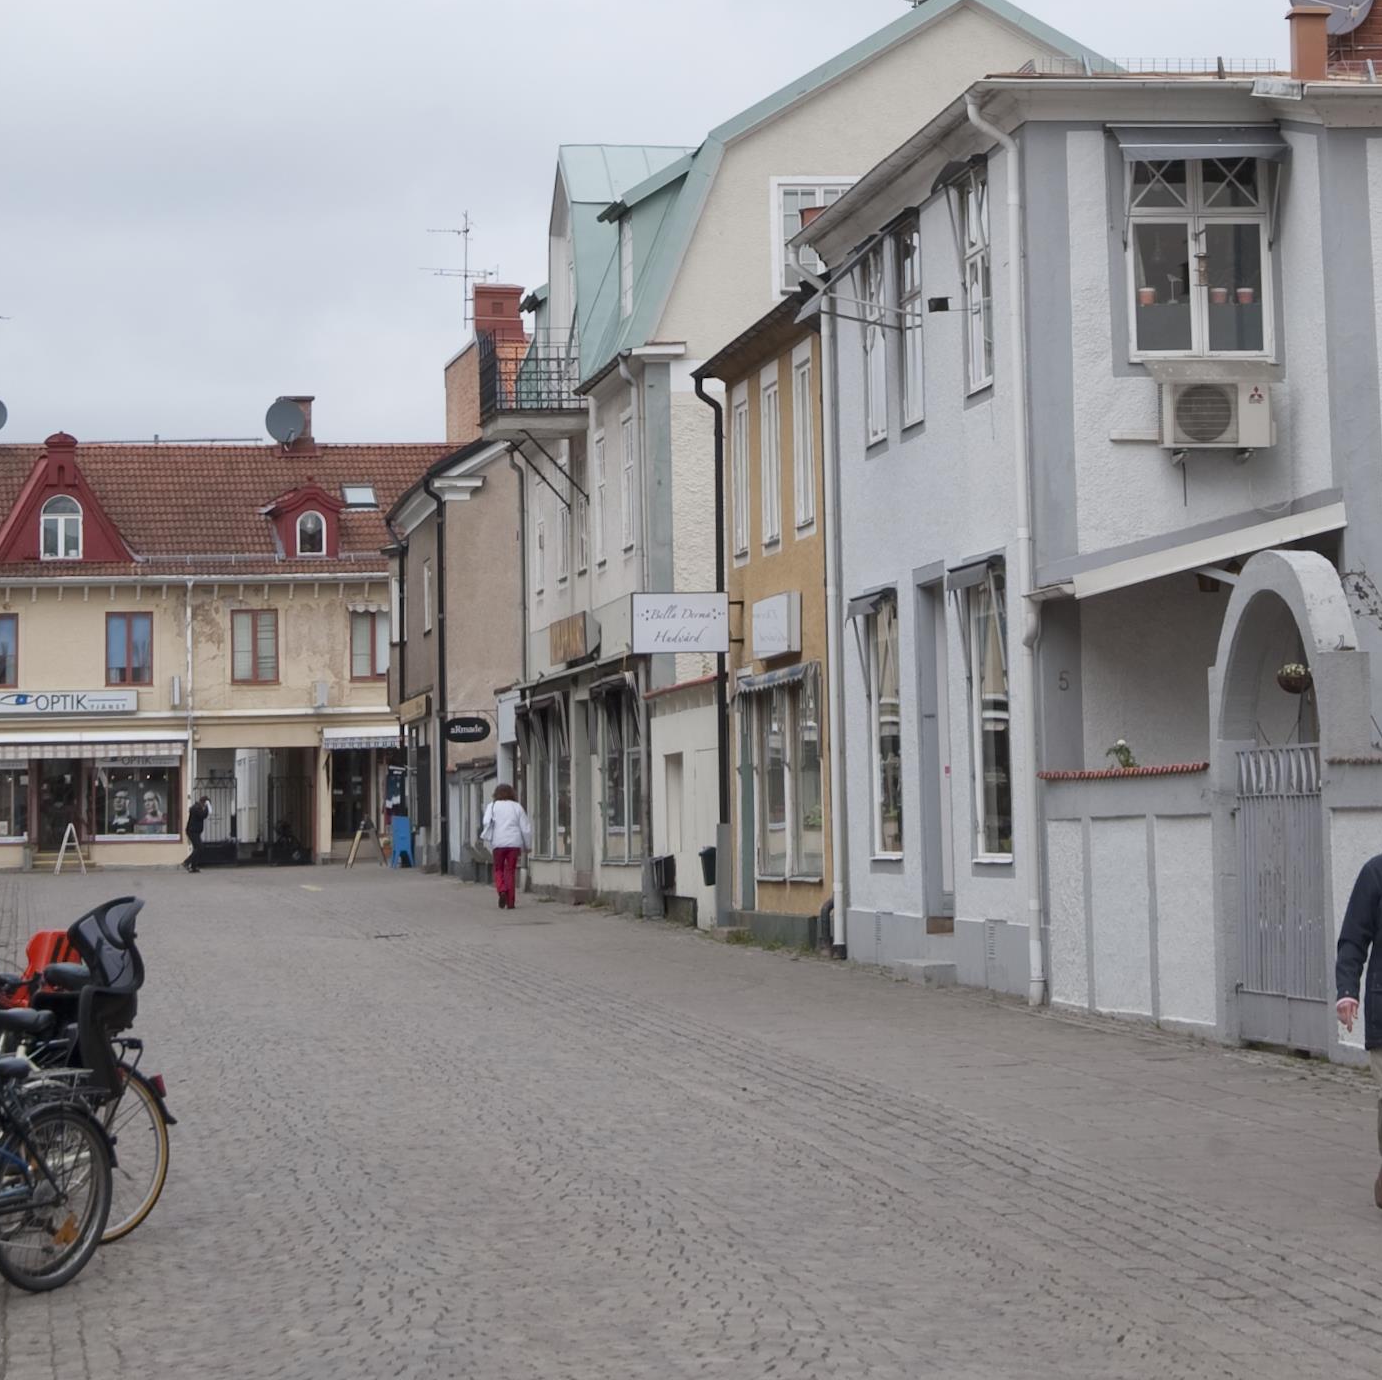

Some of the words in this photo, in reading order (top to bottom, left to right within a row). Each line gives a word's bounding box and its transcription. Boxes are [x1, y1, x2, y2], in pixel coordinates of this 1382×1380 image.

[650, 604, 678, 620] Bella
[681, 608, 712, 620] Derma
[653, 626, 709, 644] Hudvård
[1058, 670, 1070, 691] 5
[35, 693, 88, 711] OPTIK
